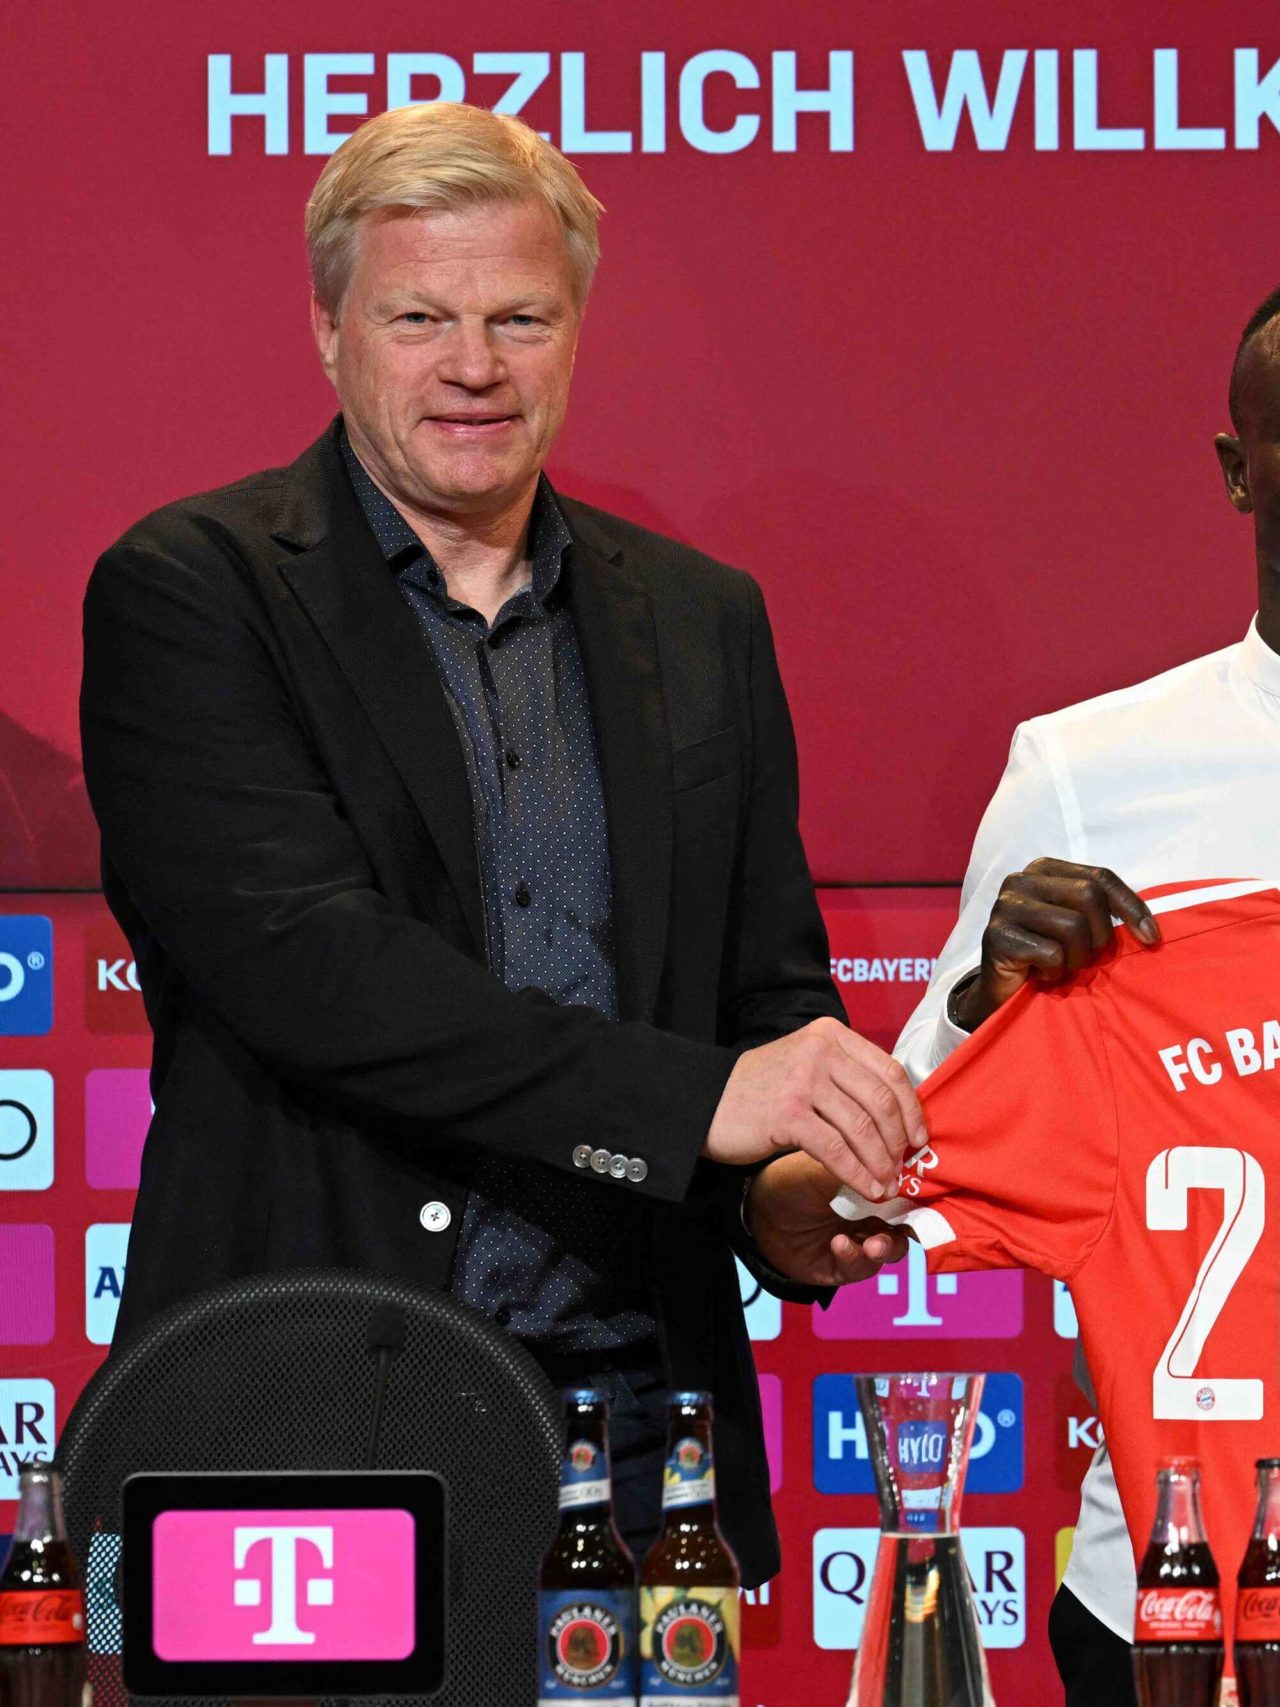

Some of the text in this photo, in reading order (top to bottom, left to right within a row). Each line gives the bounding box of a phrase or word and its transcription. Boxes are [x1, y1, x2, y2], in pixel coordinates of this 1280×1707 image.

[207, 50, 854, 155] HERZLICH
[1158, 1038, 1223, 1092] FC
[1067, 1416, 1105, 1448] K
[550, 1606, 617, 1637] PAULANER
[655, 1601, 723, 1635] PAULANER
